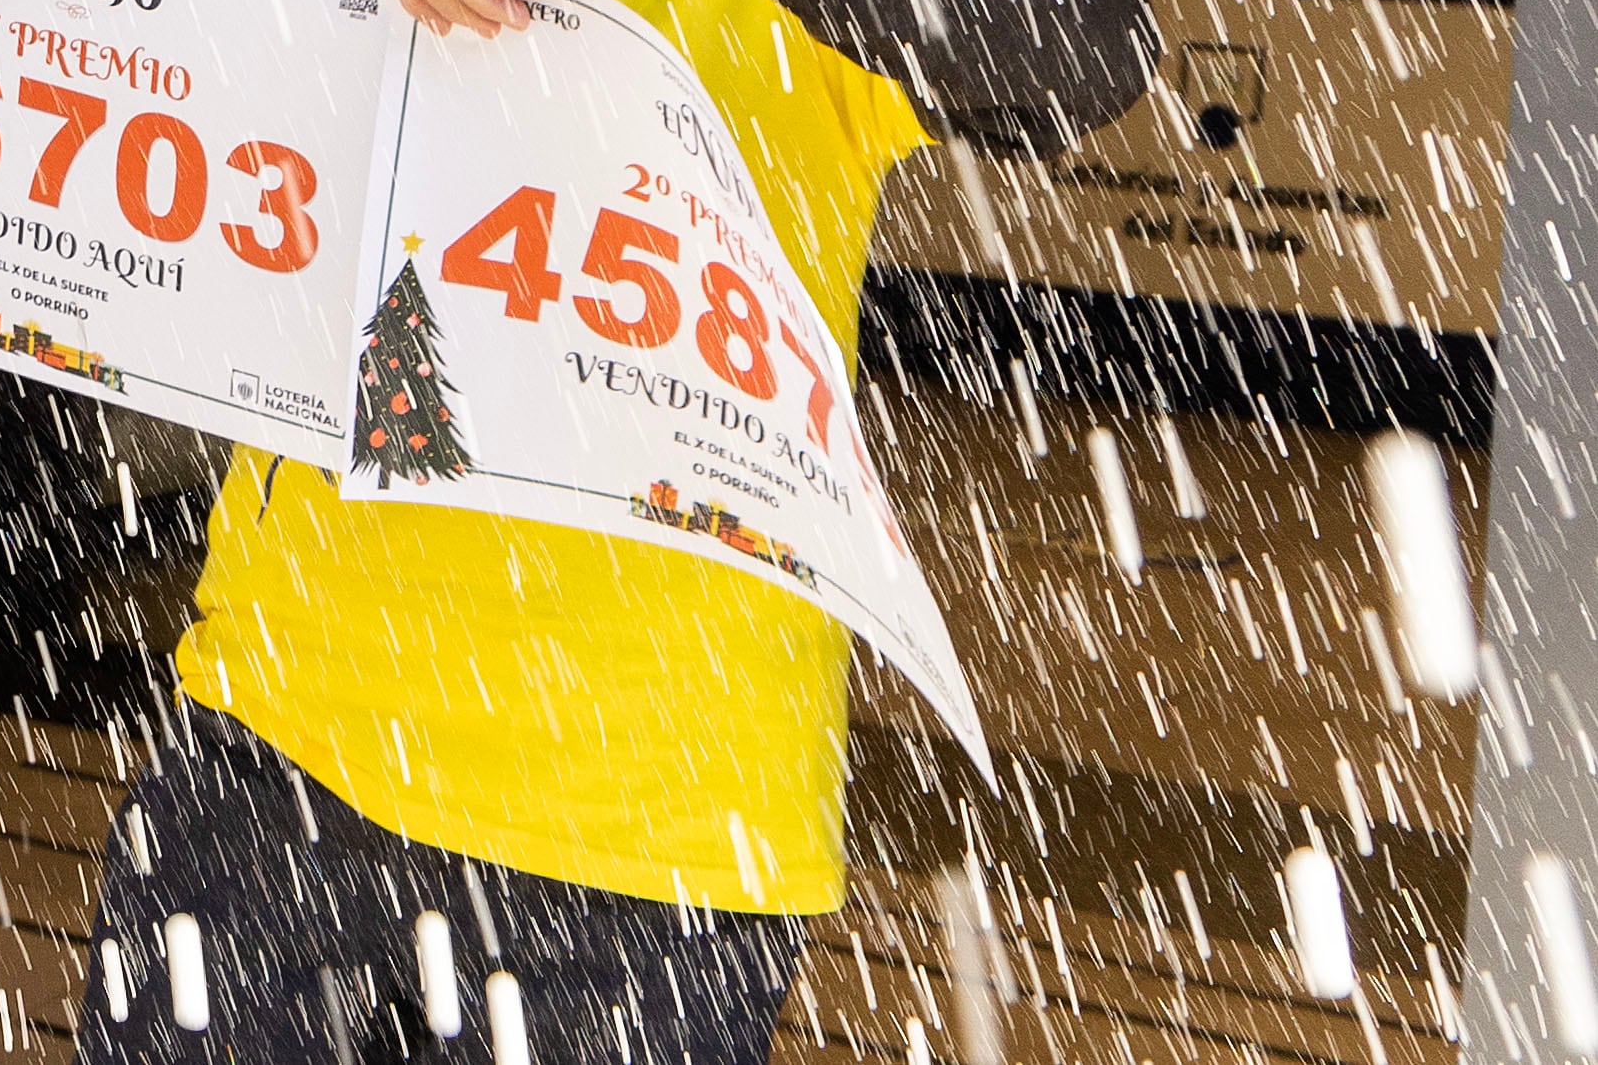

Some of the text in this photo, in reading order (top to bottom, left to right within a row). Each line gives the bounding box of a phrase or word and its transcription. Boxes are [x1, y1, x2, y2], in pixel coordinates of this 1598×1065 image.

[9, 21, 192, 102] PREMIO
[11, 263, 21, 276] X
[22, 267, 40, 282] DE
[41, 272, 58, 288] LA
[61, 279, 109, 303] SUERTE
[83, 239, 185, 293] AQUÍ
[11, 287, 90, 321] O PORRIÑO
[264, 398, 341, 429] NACIONAL
[265, 384, 326, 412] LOTERÍA
[565, 351, 766, 444] VENDIDO
[674, 431, 799, 497] EL X DE LA SUERTE
[692, 462, 705, 475] O
